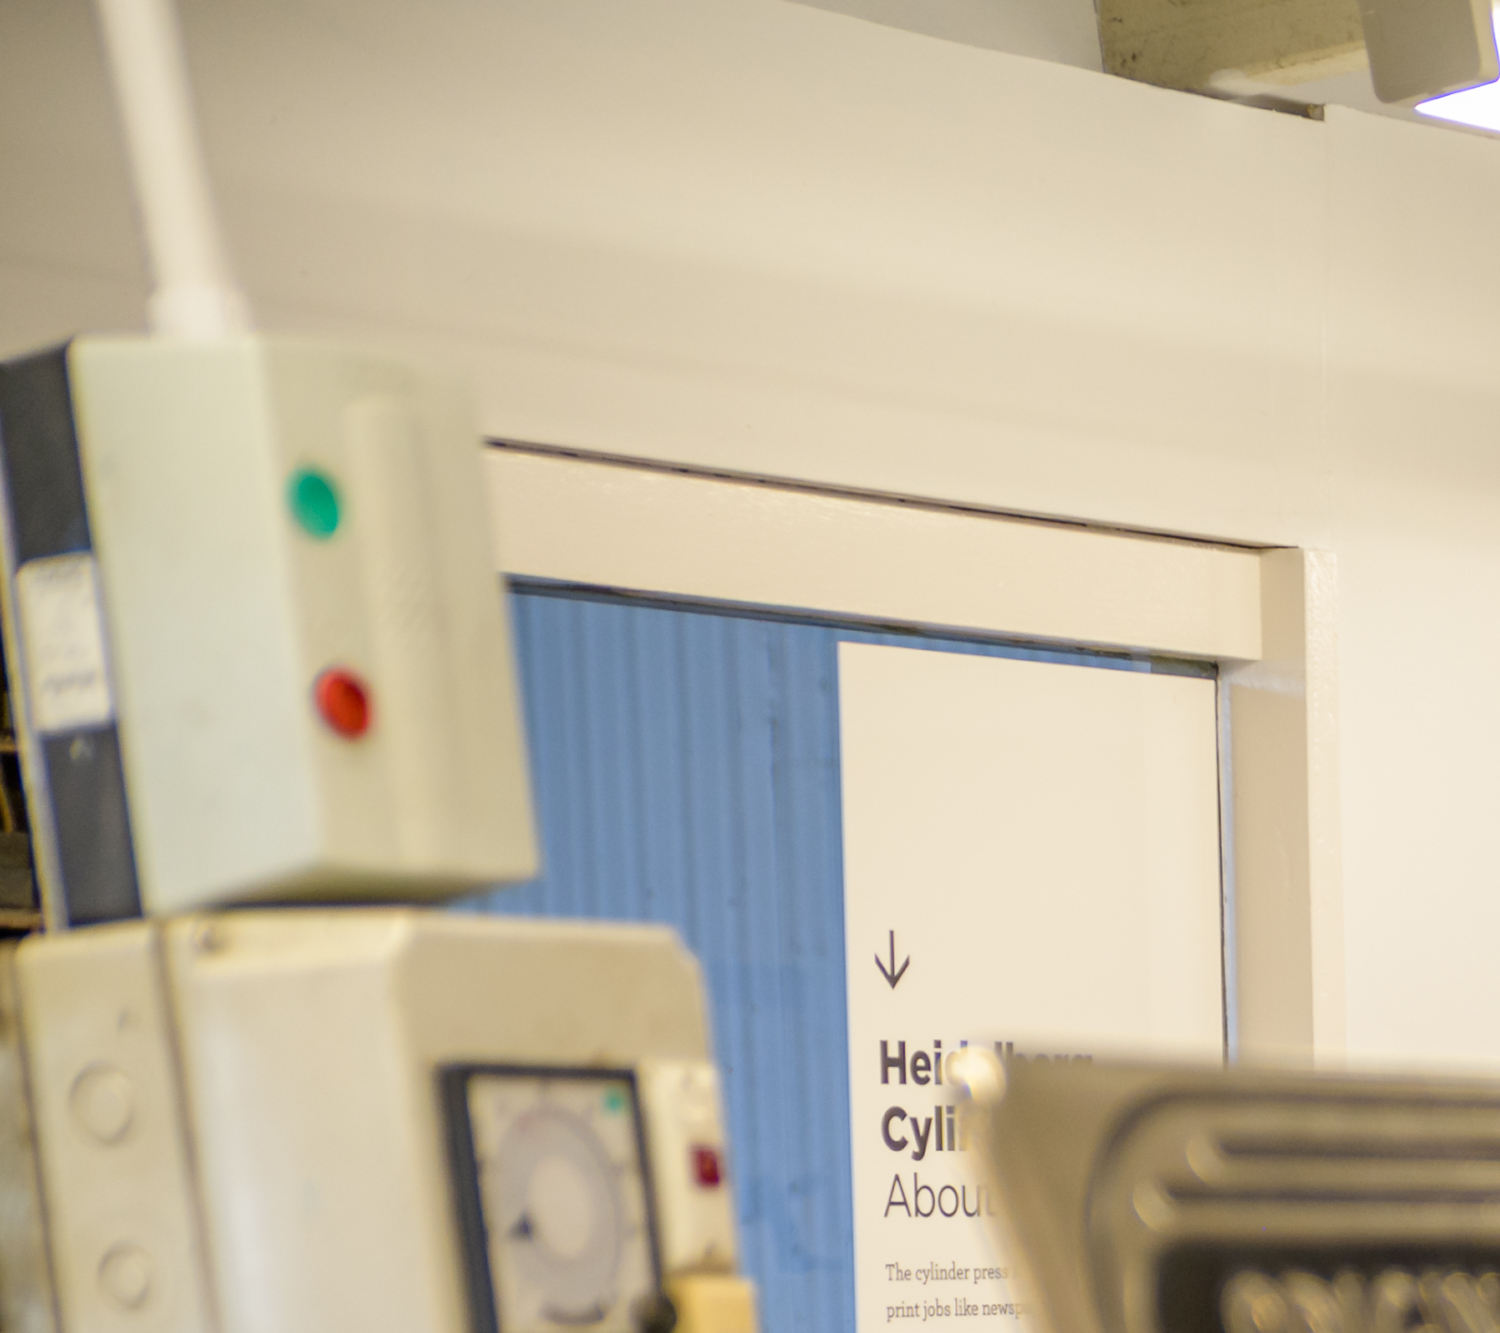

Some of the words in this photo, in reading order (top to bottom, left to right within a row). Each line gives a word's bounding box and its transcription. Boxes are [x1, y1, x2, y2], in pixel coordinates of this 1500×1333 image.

[885, 1262, 912, 1281] The
[915, 1261, 970, 1285] cylinder
[887, 1301, 920, 1323] print
[923, 1298, 951, 1322] jobs
[955, 1298, 979, 1316] like
